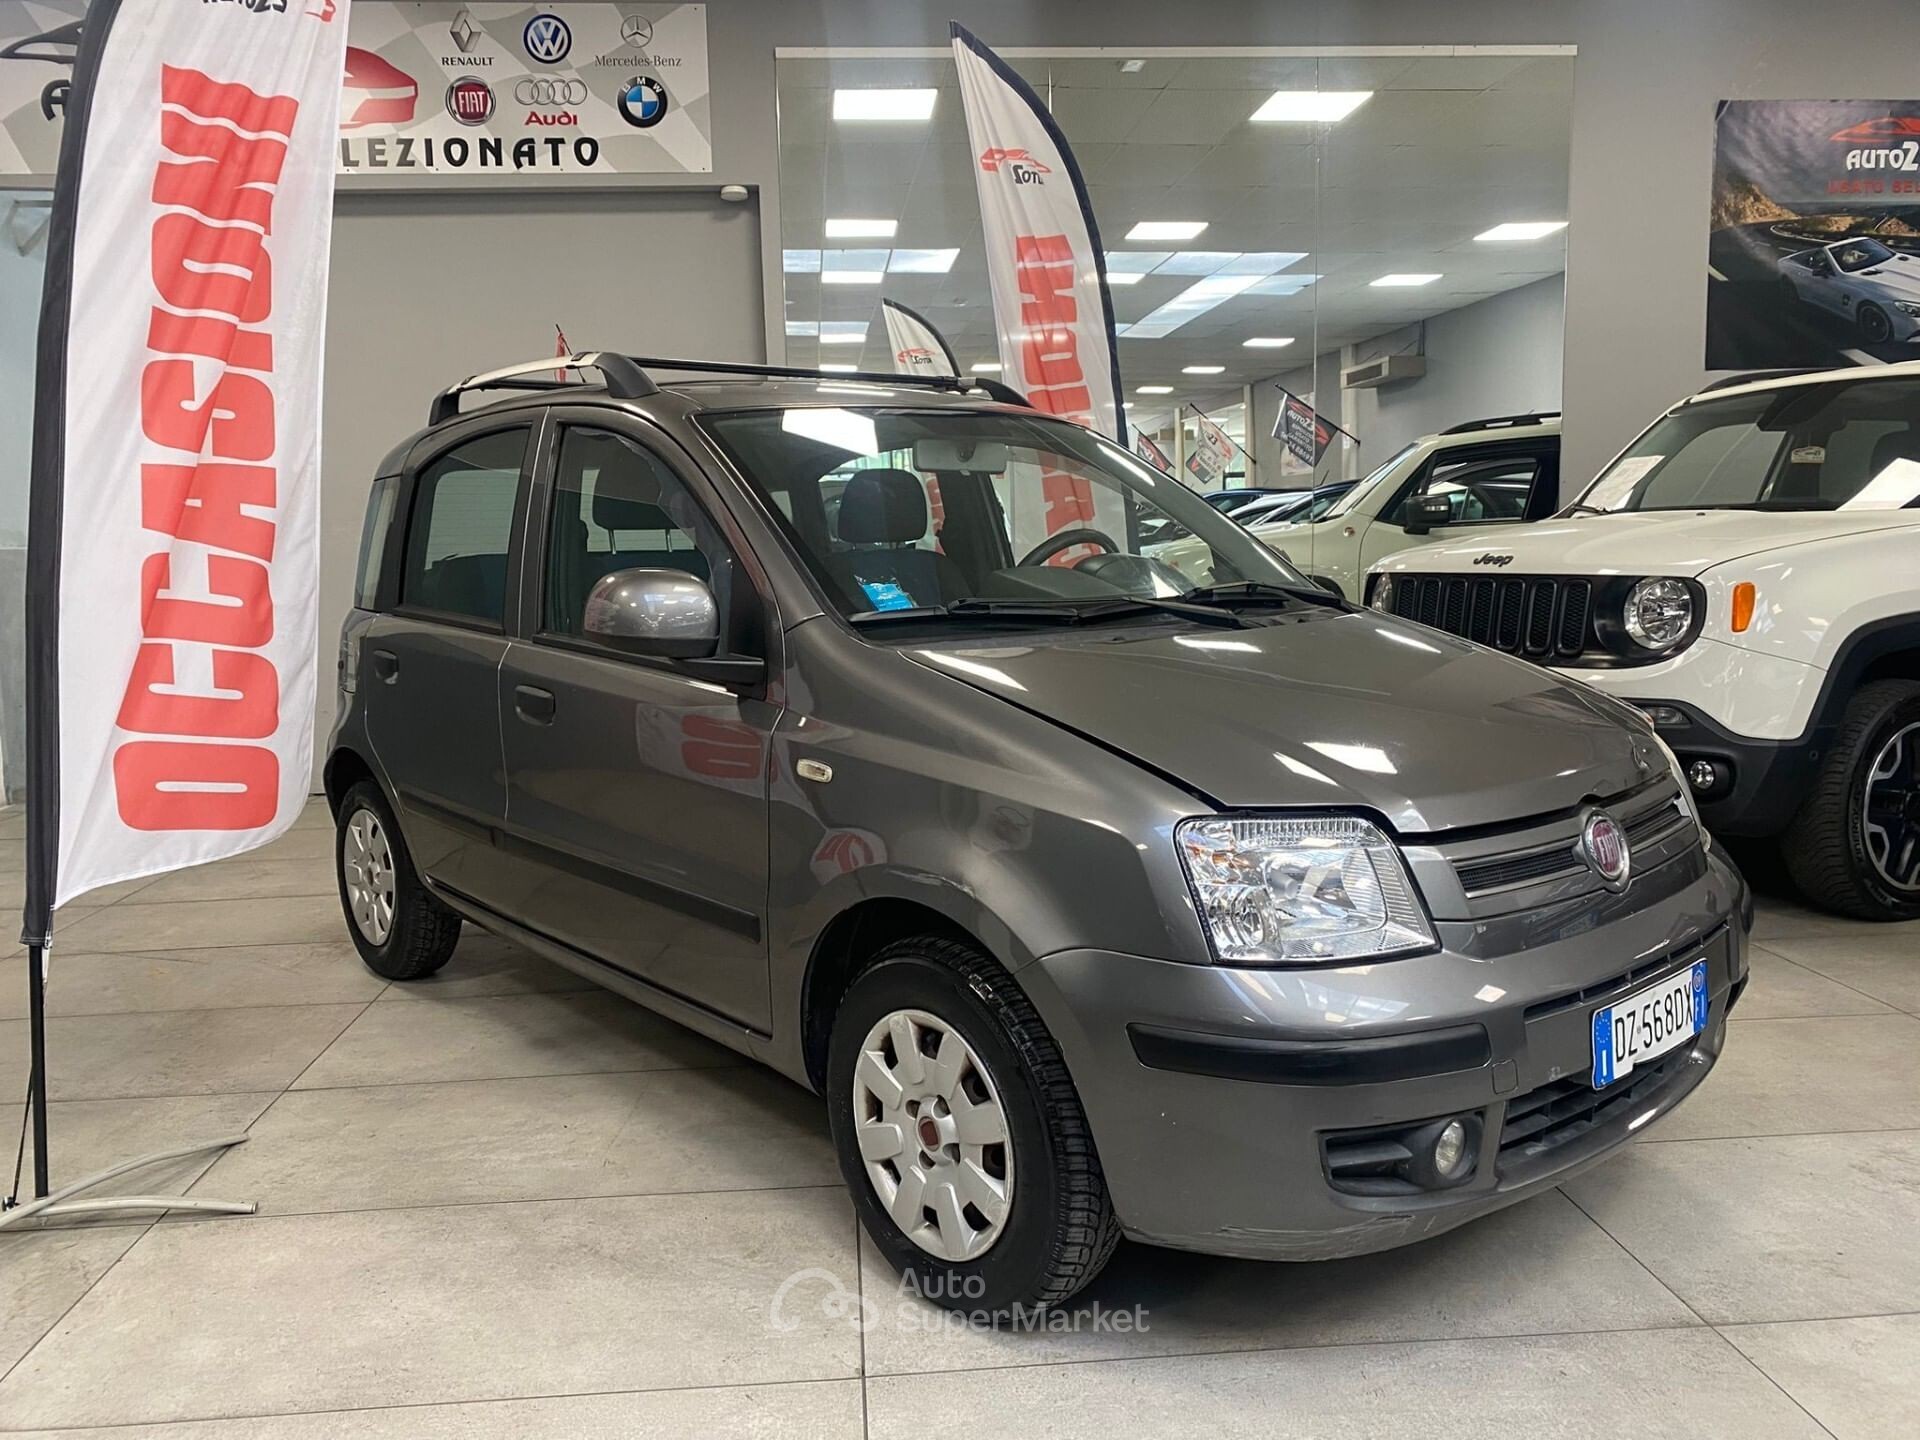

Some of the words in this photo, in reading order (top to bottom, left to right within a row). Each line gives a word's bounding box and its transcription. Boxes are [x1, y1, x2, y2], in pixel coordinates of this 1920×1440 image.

[441, 57, 495, 66] RENAULT
[595, 55, 682, 67] Mercedes-Benz
[458, 91, 486, 113] FIAT
[524, 111, 578, 126] Audi
[1473, 553, 1514, 567] Jeep
